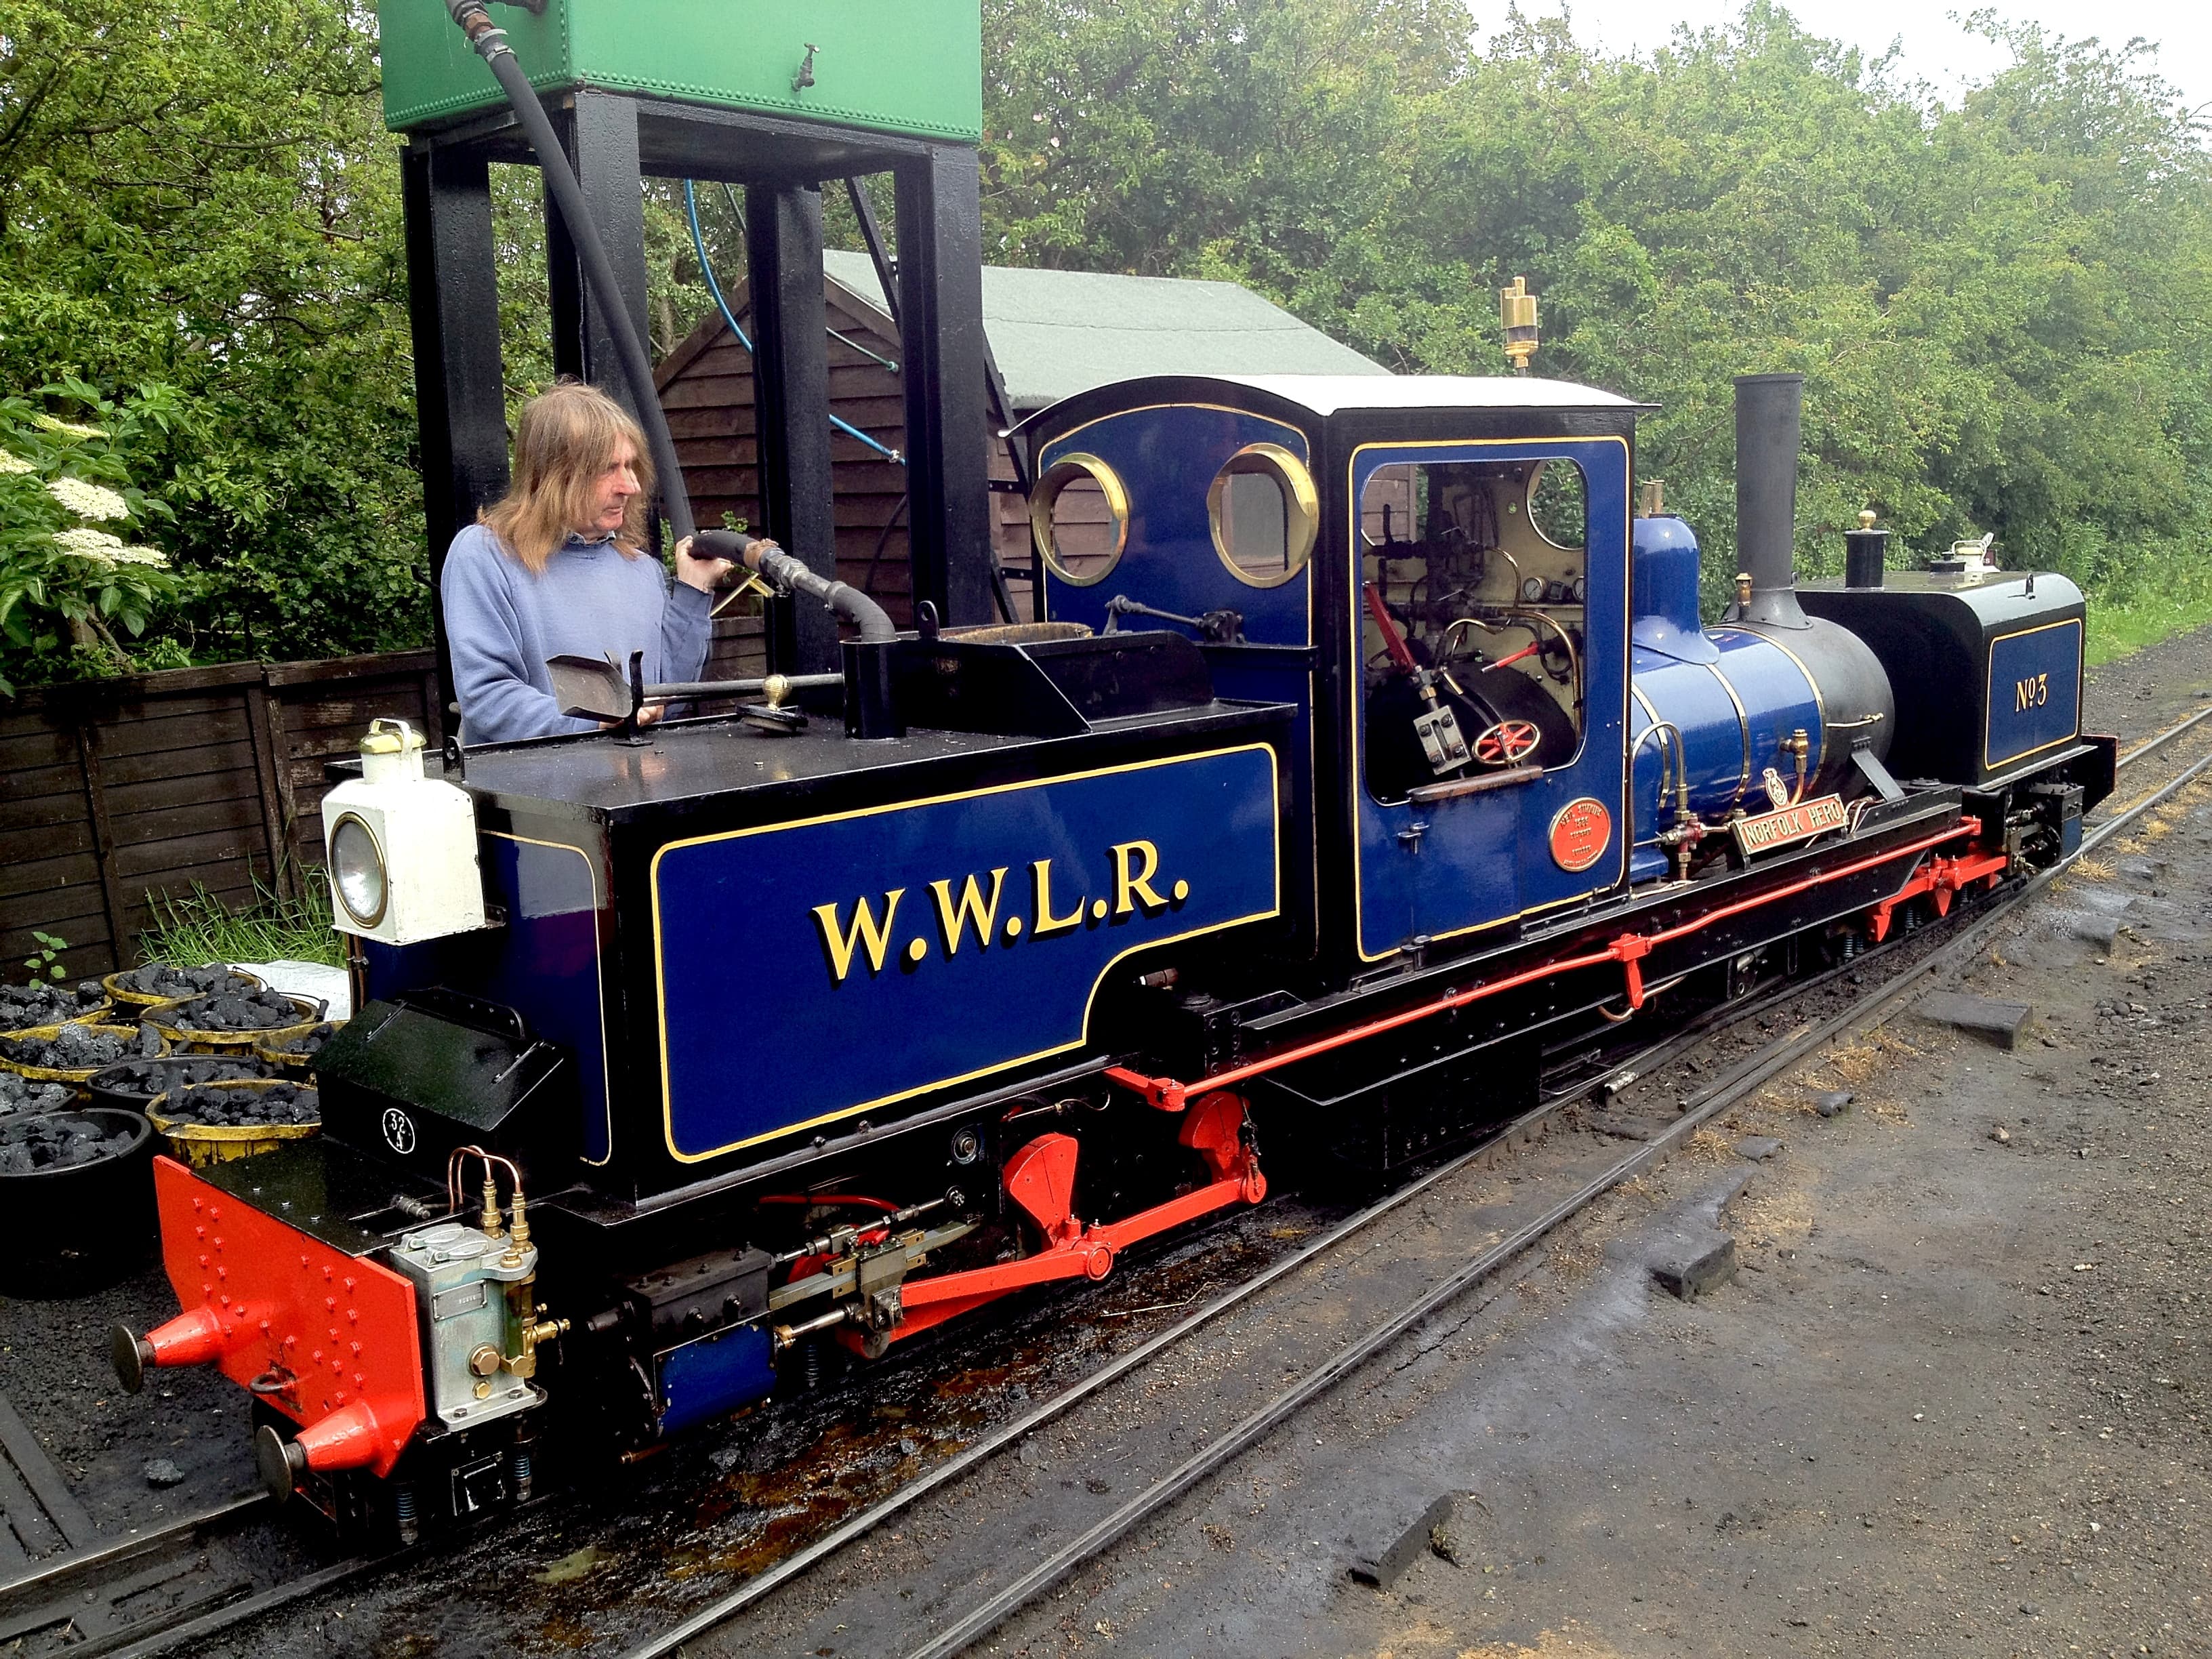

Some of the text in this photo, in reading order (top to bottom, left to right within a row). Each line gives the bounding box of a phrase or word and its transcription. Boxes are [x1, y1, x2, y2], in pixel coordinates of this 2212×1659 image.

[1743, 802, 1841, 846] NORFOLK HERO
[811, 840, 1189, 983] W.W.L.R.
[390, 1113, 405, 1134] 32
